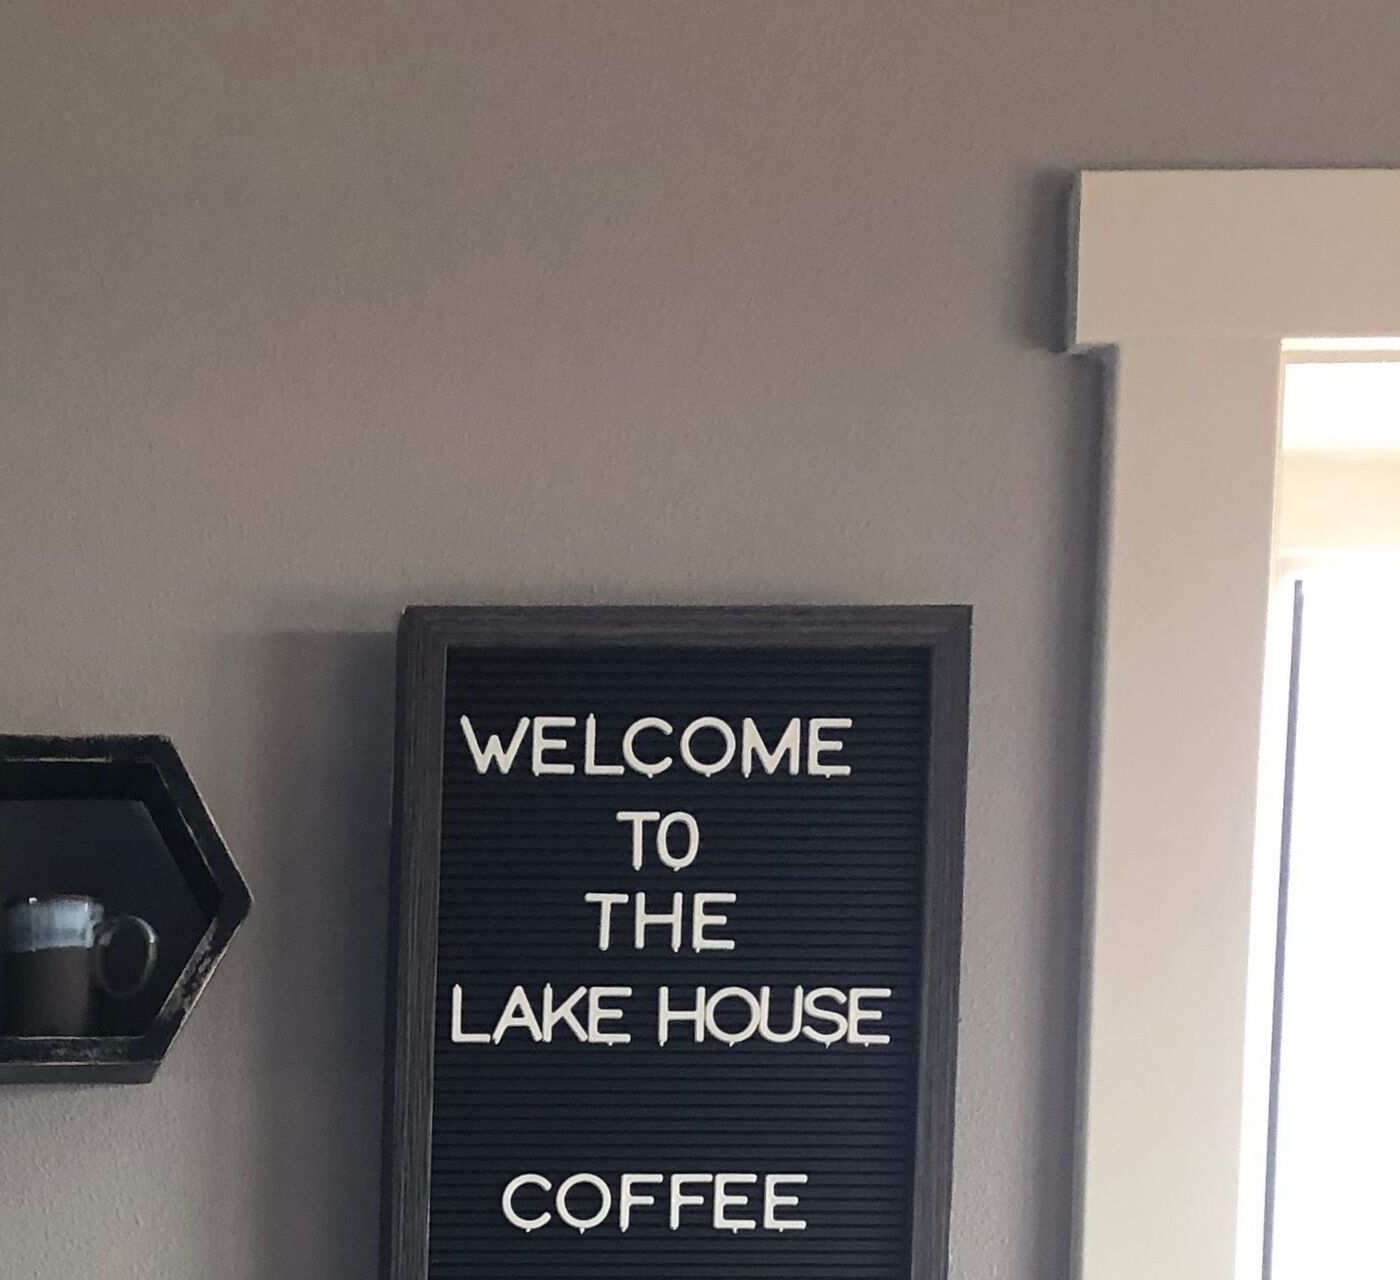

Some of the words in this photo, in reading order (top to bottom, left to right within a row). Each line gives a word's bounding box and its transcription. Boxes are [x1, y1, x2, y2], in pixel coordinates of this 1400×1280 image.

[459, 712, 853, 778] WELCOME
[616, 811, 700, 872] TO
[584, 891, 737, 954] THE
[451, 982, 633, 1046] LAKE
[658, 984, 892, 1049] HOUSE
[501, 1172, 809, 1234] COFFEE
